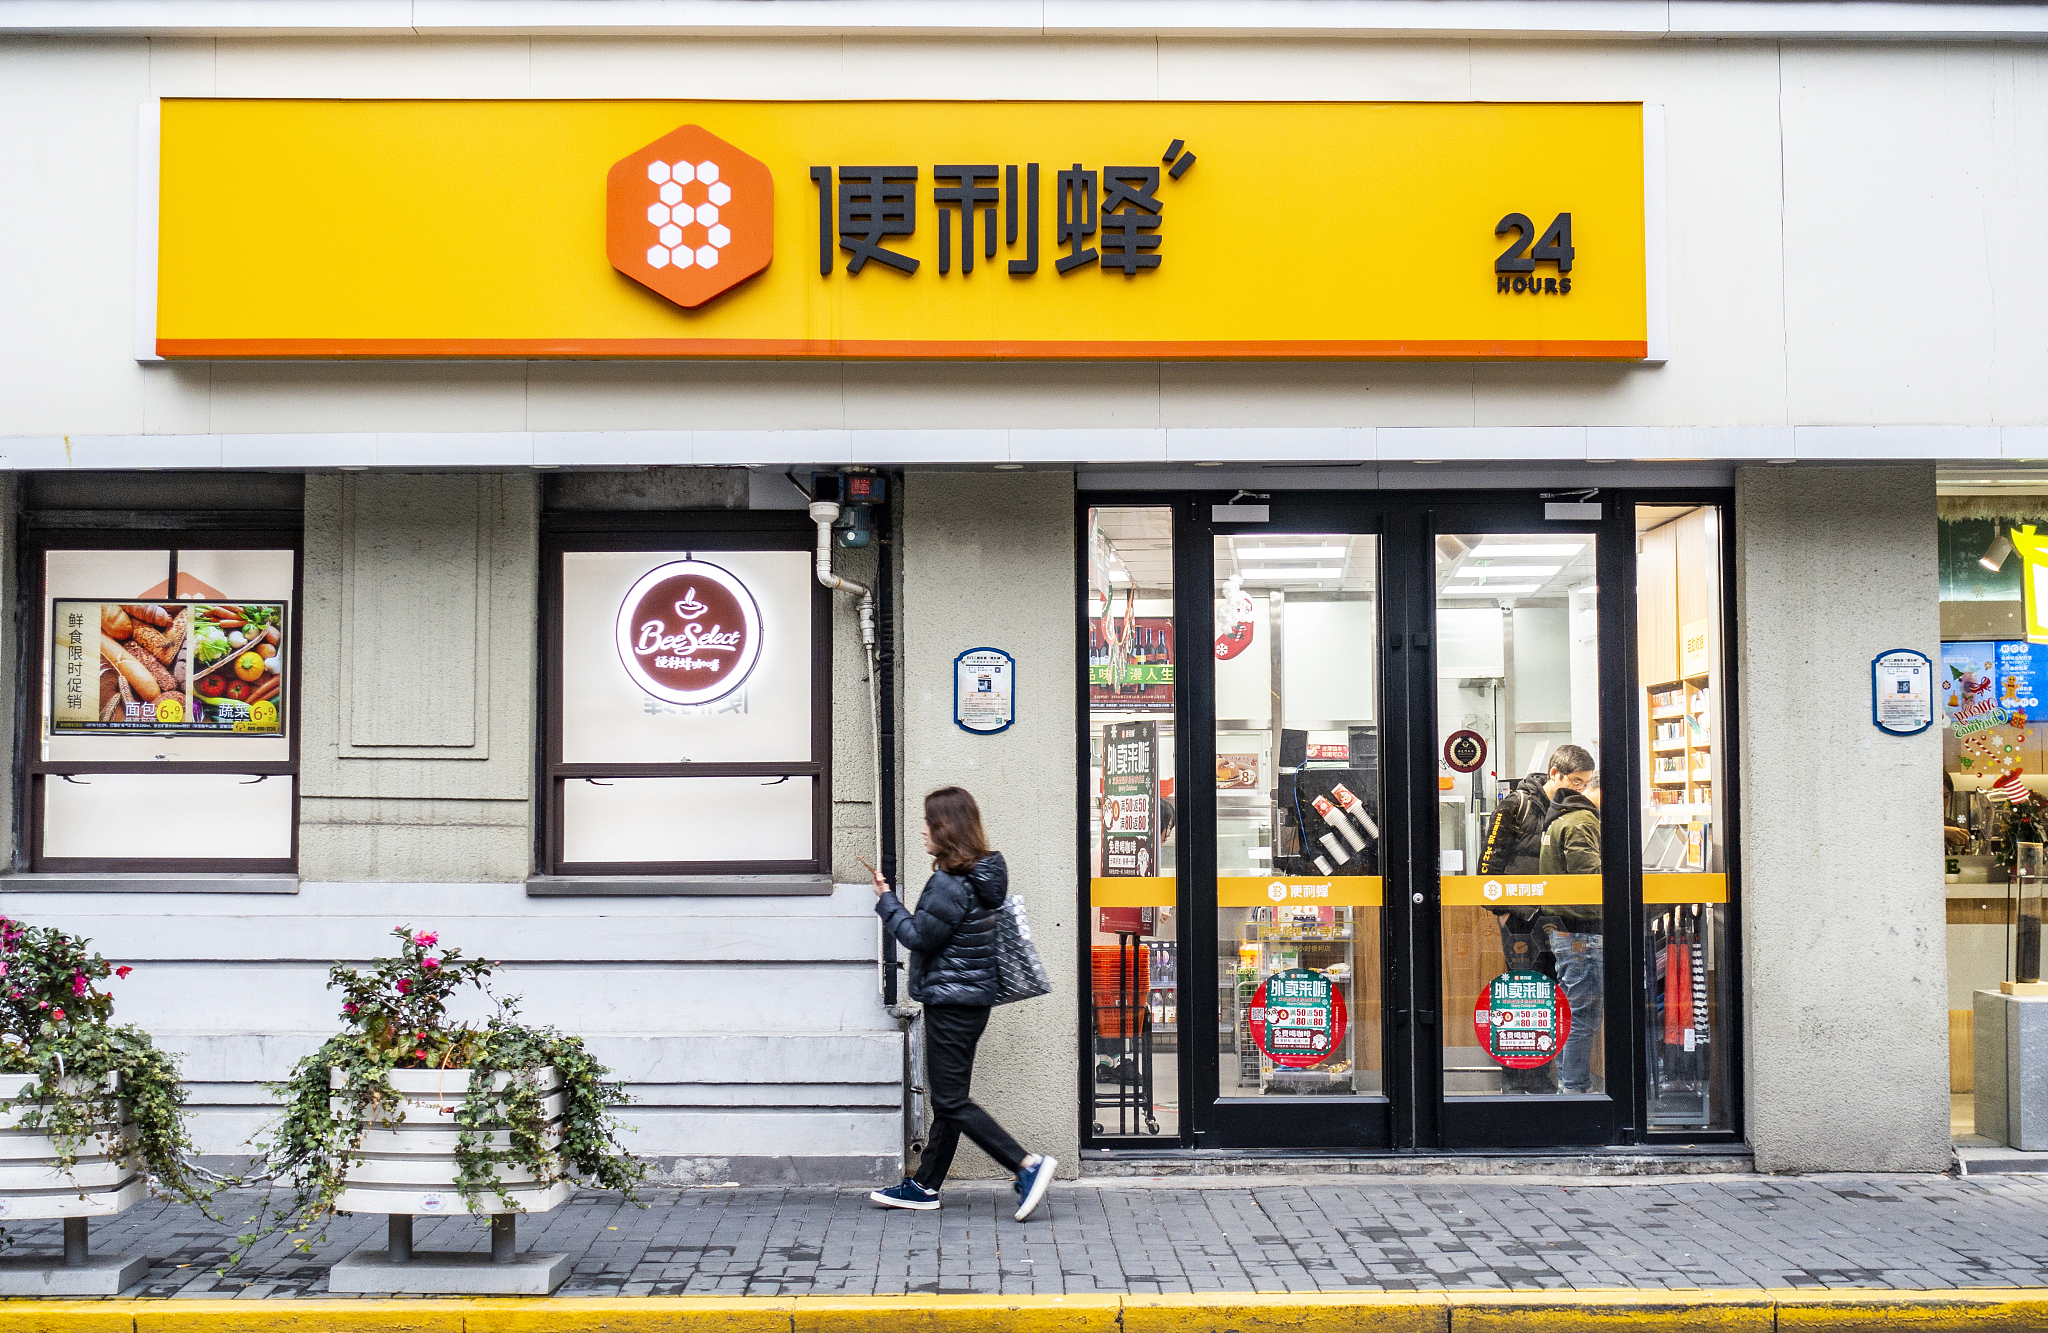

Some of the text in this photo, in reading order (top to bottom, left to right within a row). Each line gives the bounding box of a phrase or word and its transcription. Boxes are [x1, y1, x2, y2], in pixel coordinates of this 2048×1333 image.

[810, 162, 1164, 276] 便利蜂
[1495, 212, 1575, 273] 24
[1497, 277, 1572, 294] HOURS
[67, 613, 83, 709] 鲜食限时促销
[654, 656, 720, 671] 便利蜂咖啡
[1089, 667, 1174, 681] 品味漫人生
[125, 702, 156, 717] 面包
[218, 703, 250, 718] 蔬菜
[1107, 742, 1149, 774] 外卖来啦
[1487, 812, 1503, 845] Moment
[1290, 883, 1329, 898] 便利蜂
[1505, 883, 1544, 897] 便利蜂
[1258, 926, 1343, 939] 泰兴路230号店
[1271, 980, 1327, 998] 外卖来啦
[1495, 982, 1550, 999] 外卖来啦
